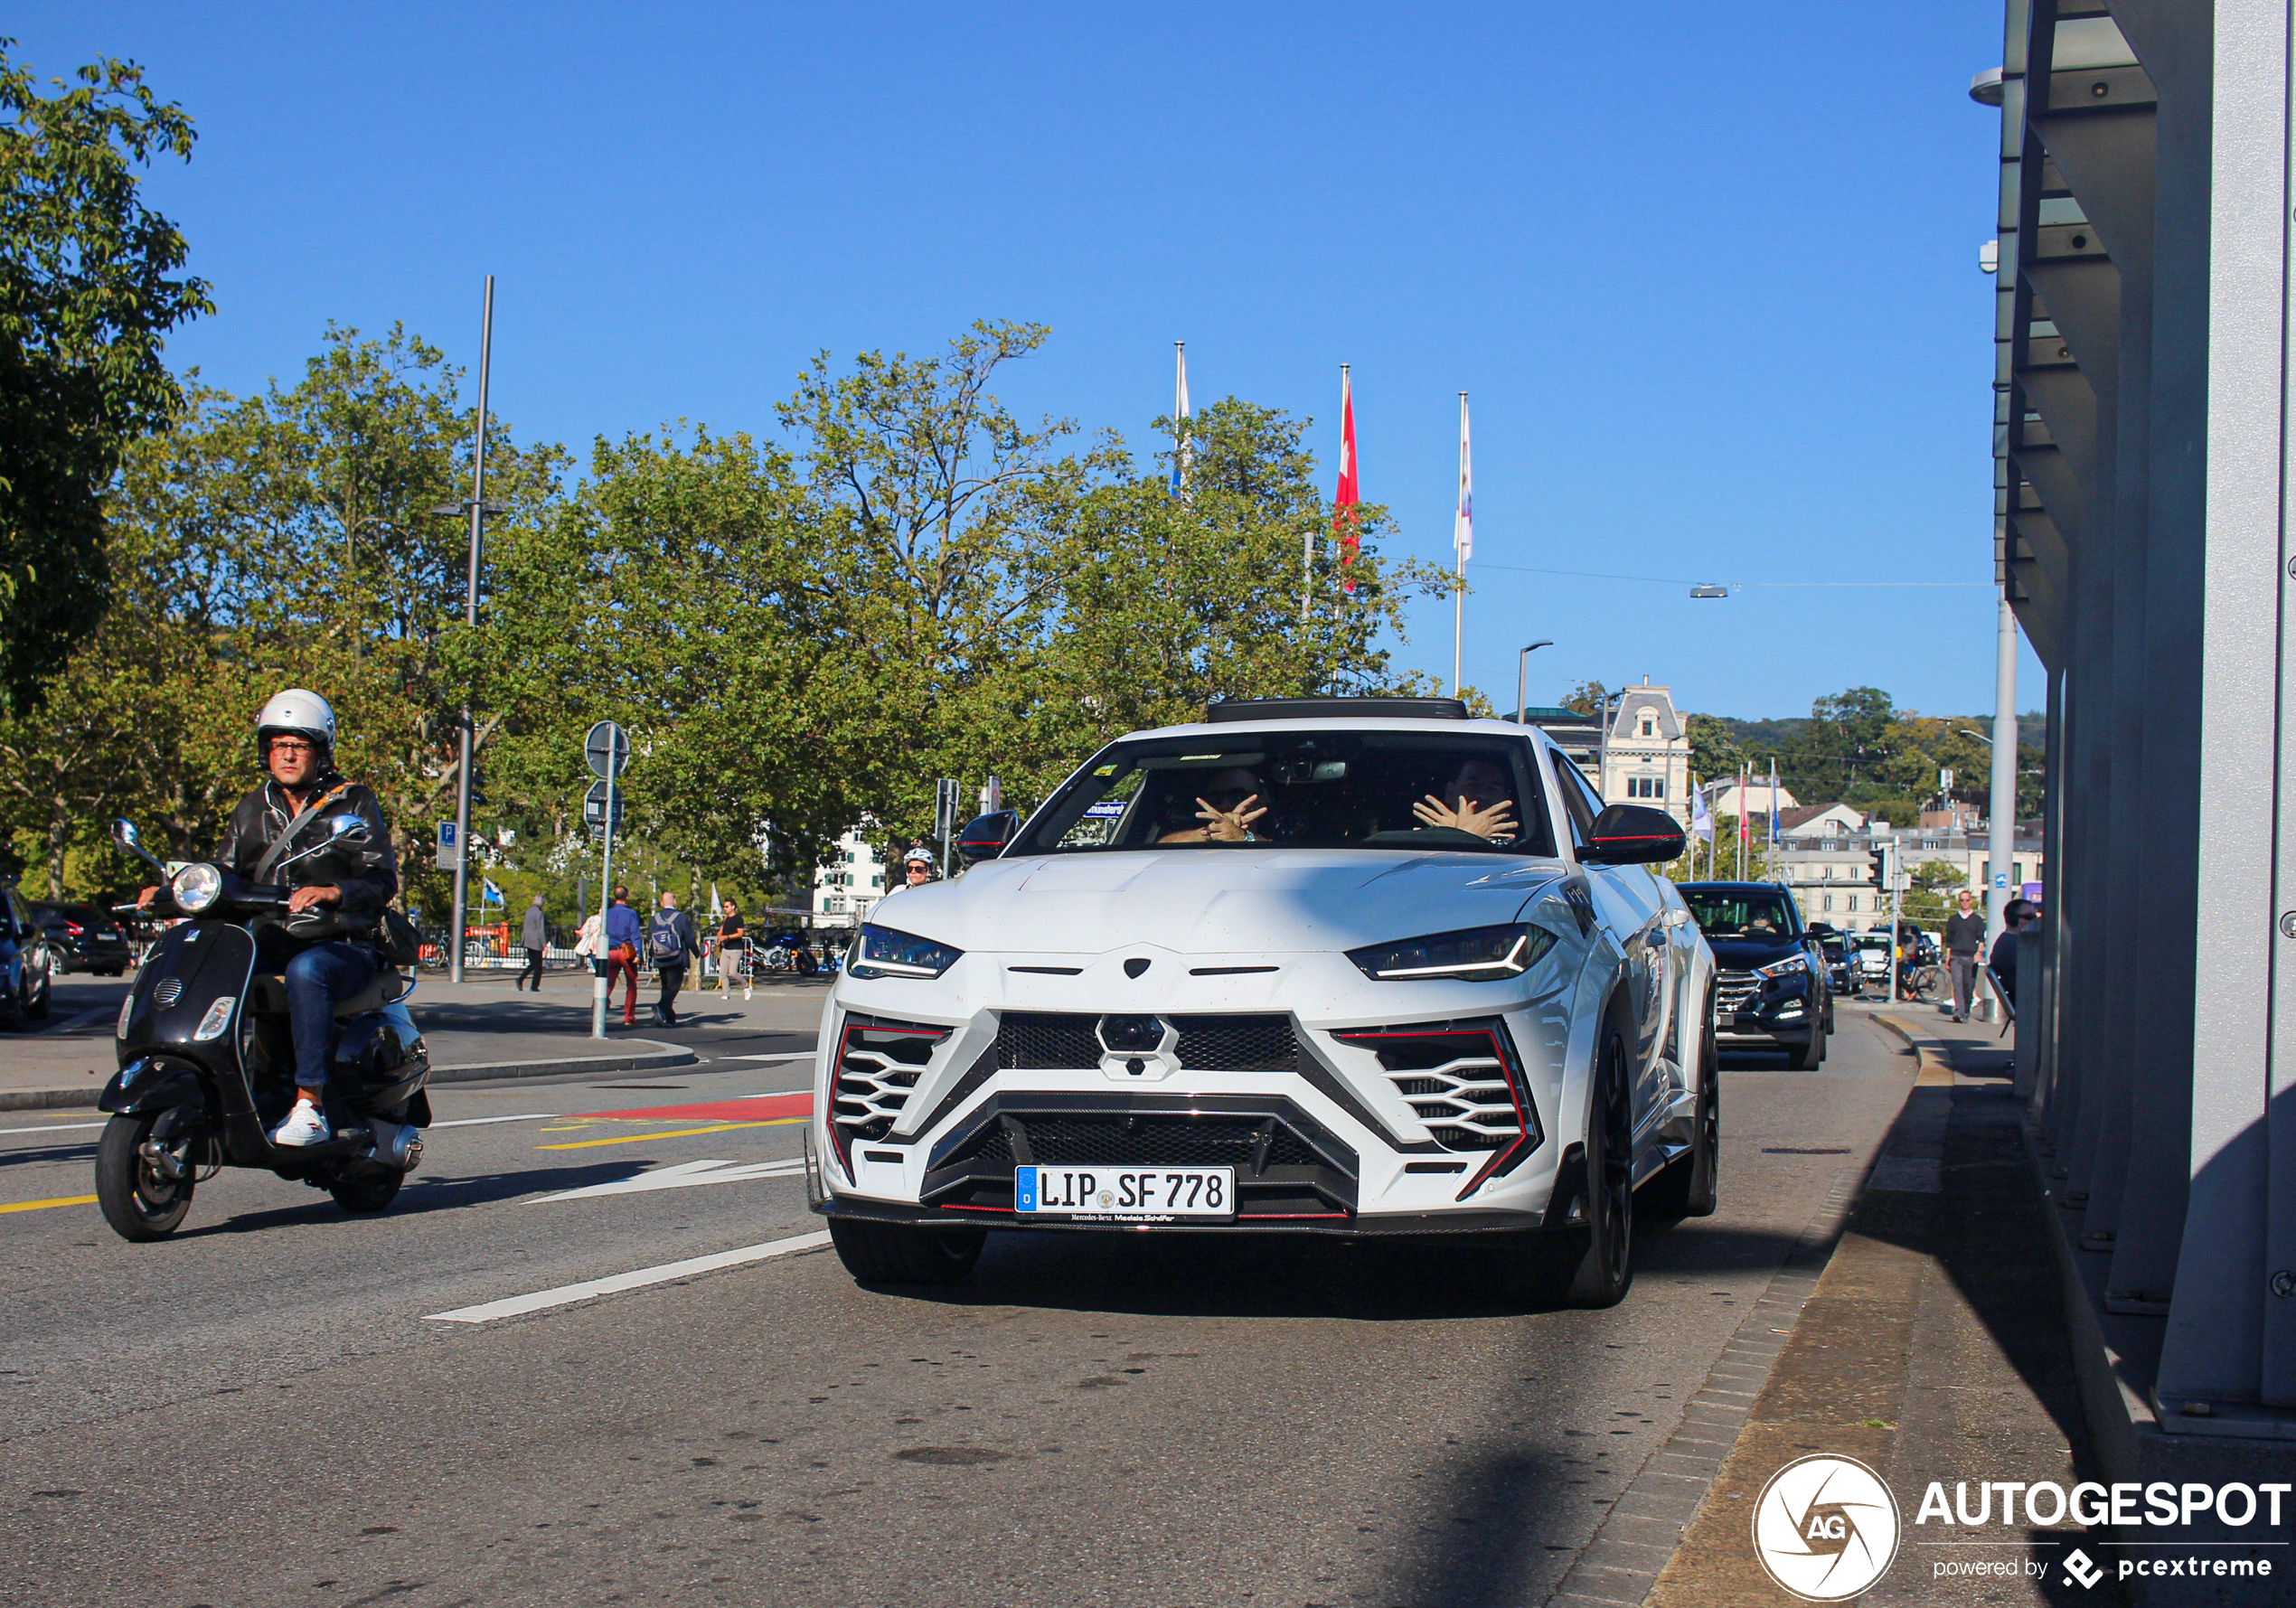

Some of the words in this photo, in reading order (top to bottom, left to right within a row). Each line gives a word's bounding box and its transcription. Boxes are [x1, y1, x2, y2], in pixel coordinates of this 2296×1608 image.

[1022, 1193, 1030, 1204] D
[1041, 1173, 1096, 1207] LIP
[1118, 1173, 1156, 1208] SF
[1166, 1174, 1223, 1208] 778
[1071, 1213, 1113, 1221] Mercedes-Benz
